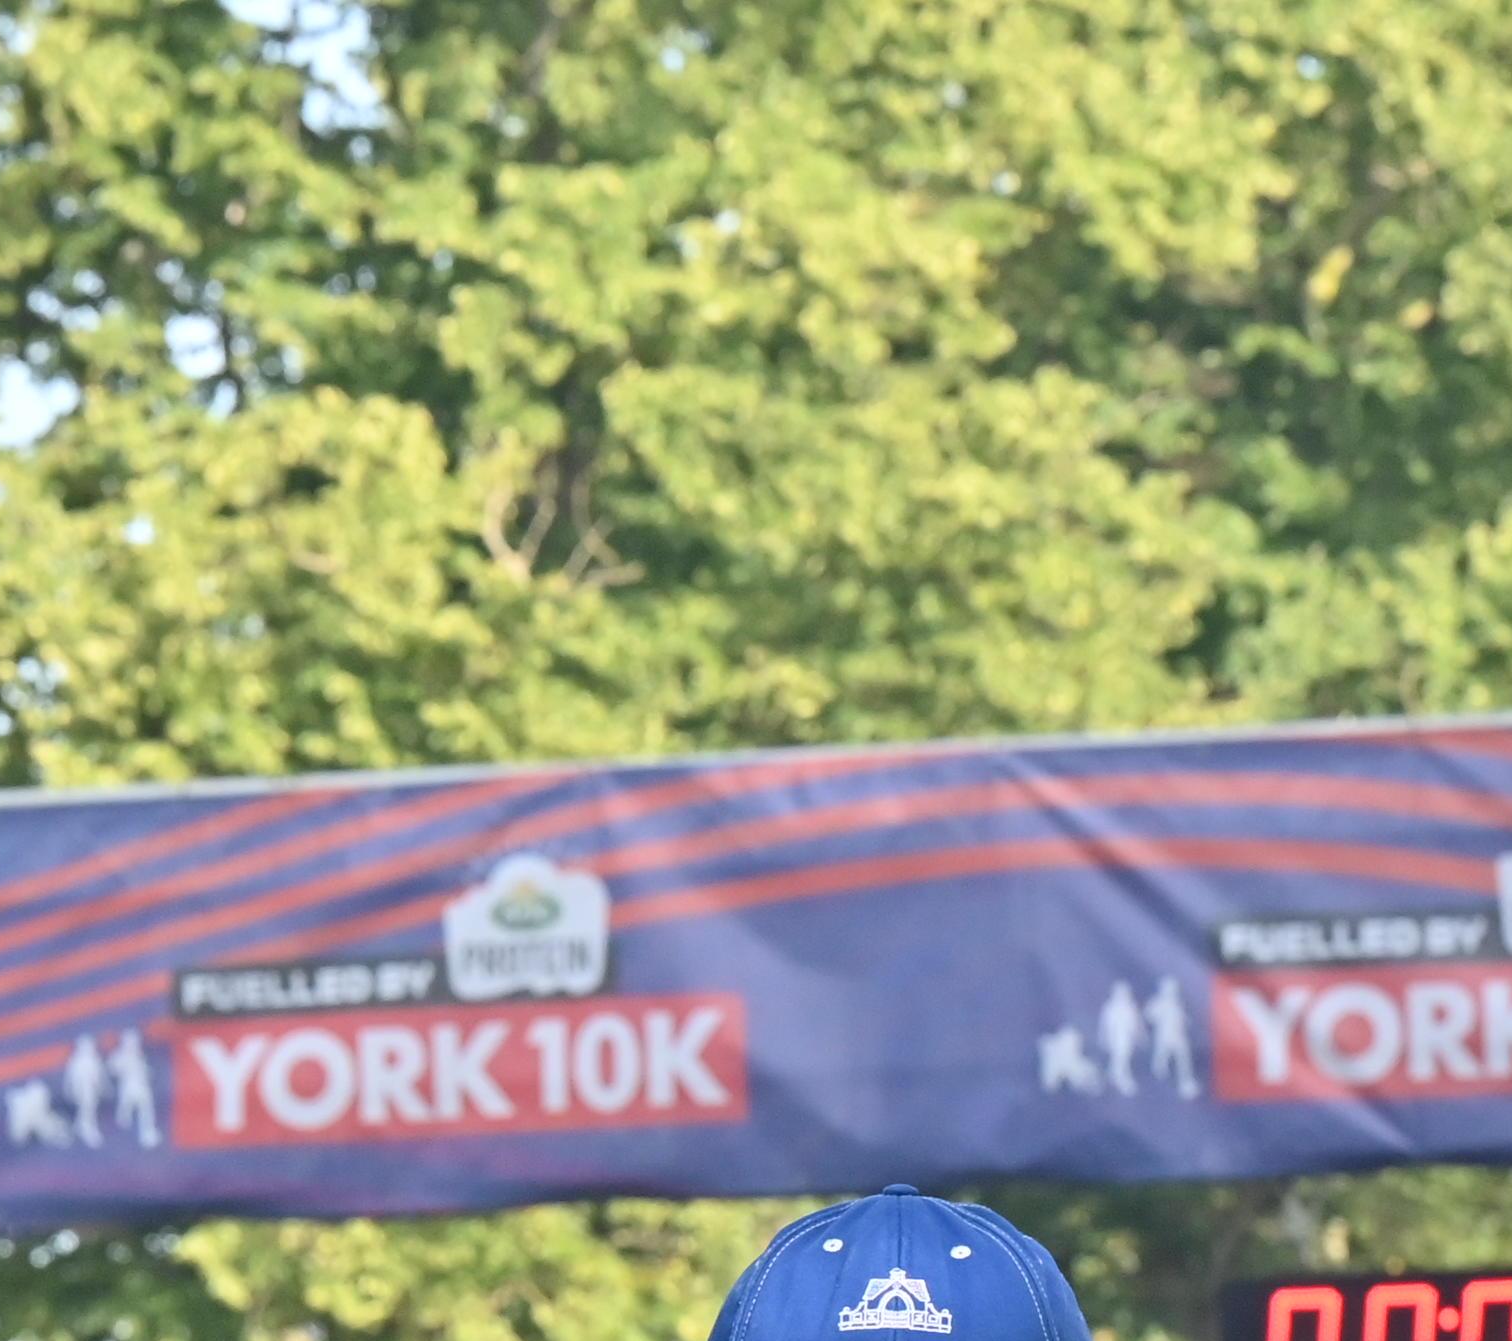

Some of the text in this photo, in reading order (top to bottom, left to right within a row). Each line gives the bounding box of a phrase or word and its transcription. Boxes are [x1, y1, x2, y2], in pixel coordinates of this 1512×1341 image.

[1220, 913, 1487, 962] FUELLED BY
[182, 961, 435, 1013] FUELLED BY
[192, 1007, 730, 1133] YORK 10K
